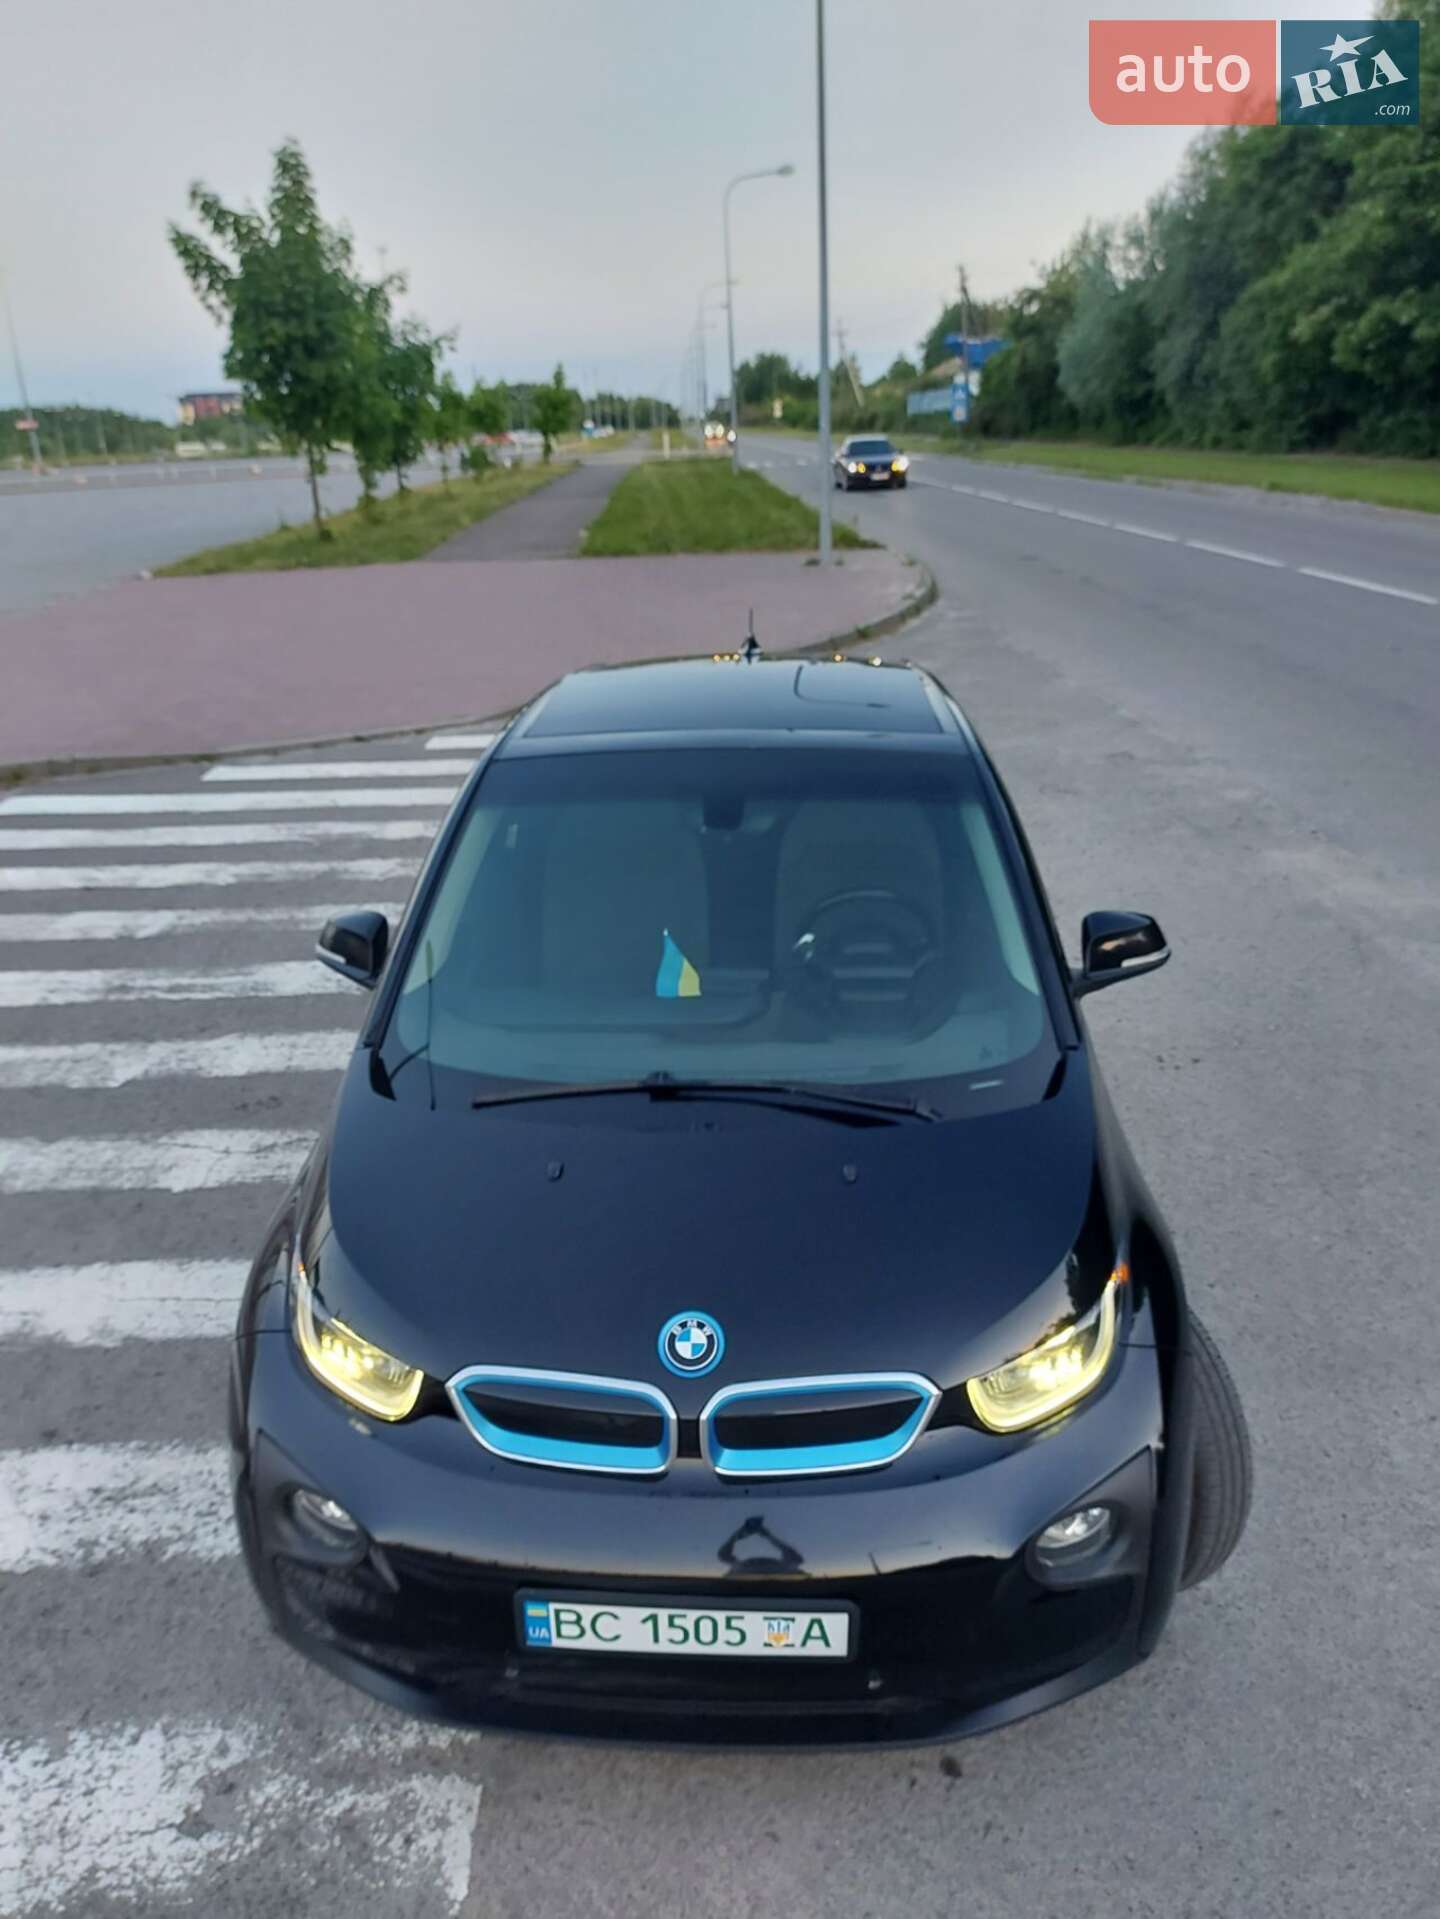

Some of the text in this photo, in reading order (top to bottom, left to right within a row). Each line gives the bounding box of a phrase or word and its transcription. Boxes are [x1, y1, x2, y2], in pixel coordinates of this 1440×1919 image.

[528, 1627, 550, 1639] UA
[554, 1608, 621, 1642] BC
[640, 1613, 747, 1647] 1505
